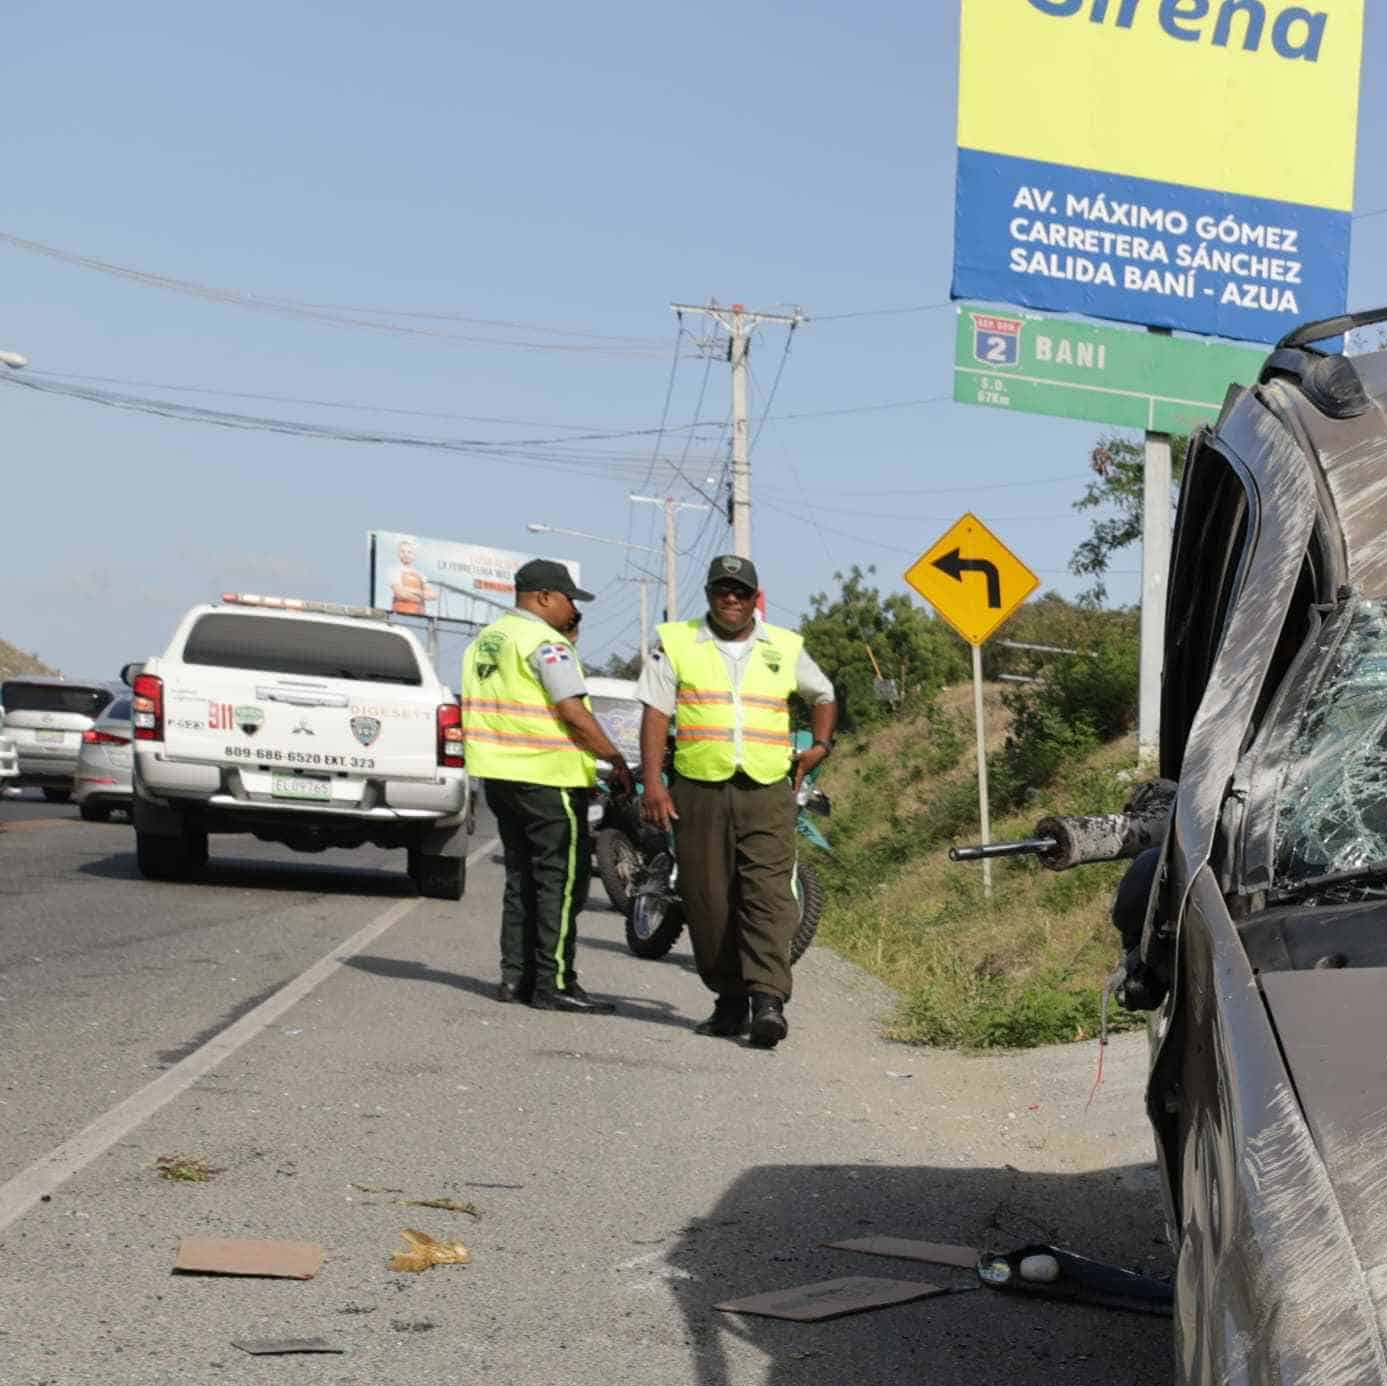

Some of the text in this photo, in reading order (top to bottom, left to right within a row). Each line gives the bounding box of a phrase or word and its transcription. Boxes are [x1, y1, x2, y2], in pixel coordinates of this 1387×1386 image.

[1013, 186, 1299, 253] AV. MÁXIMO GÓMEZ
[1009, 217, 1302, 284] CARRETERA SÁNCHEZ
[1009, 247, 1299, 314] SALIDA BANÍ - AZUA
[986, 336, 1008, 362] 2
[1035, 335, 1106, 369] BANI
[208, 703, 233, 731] 911
